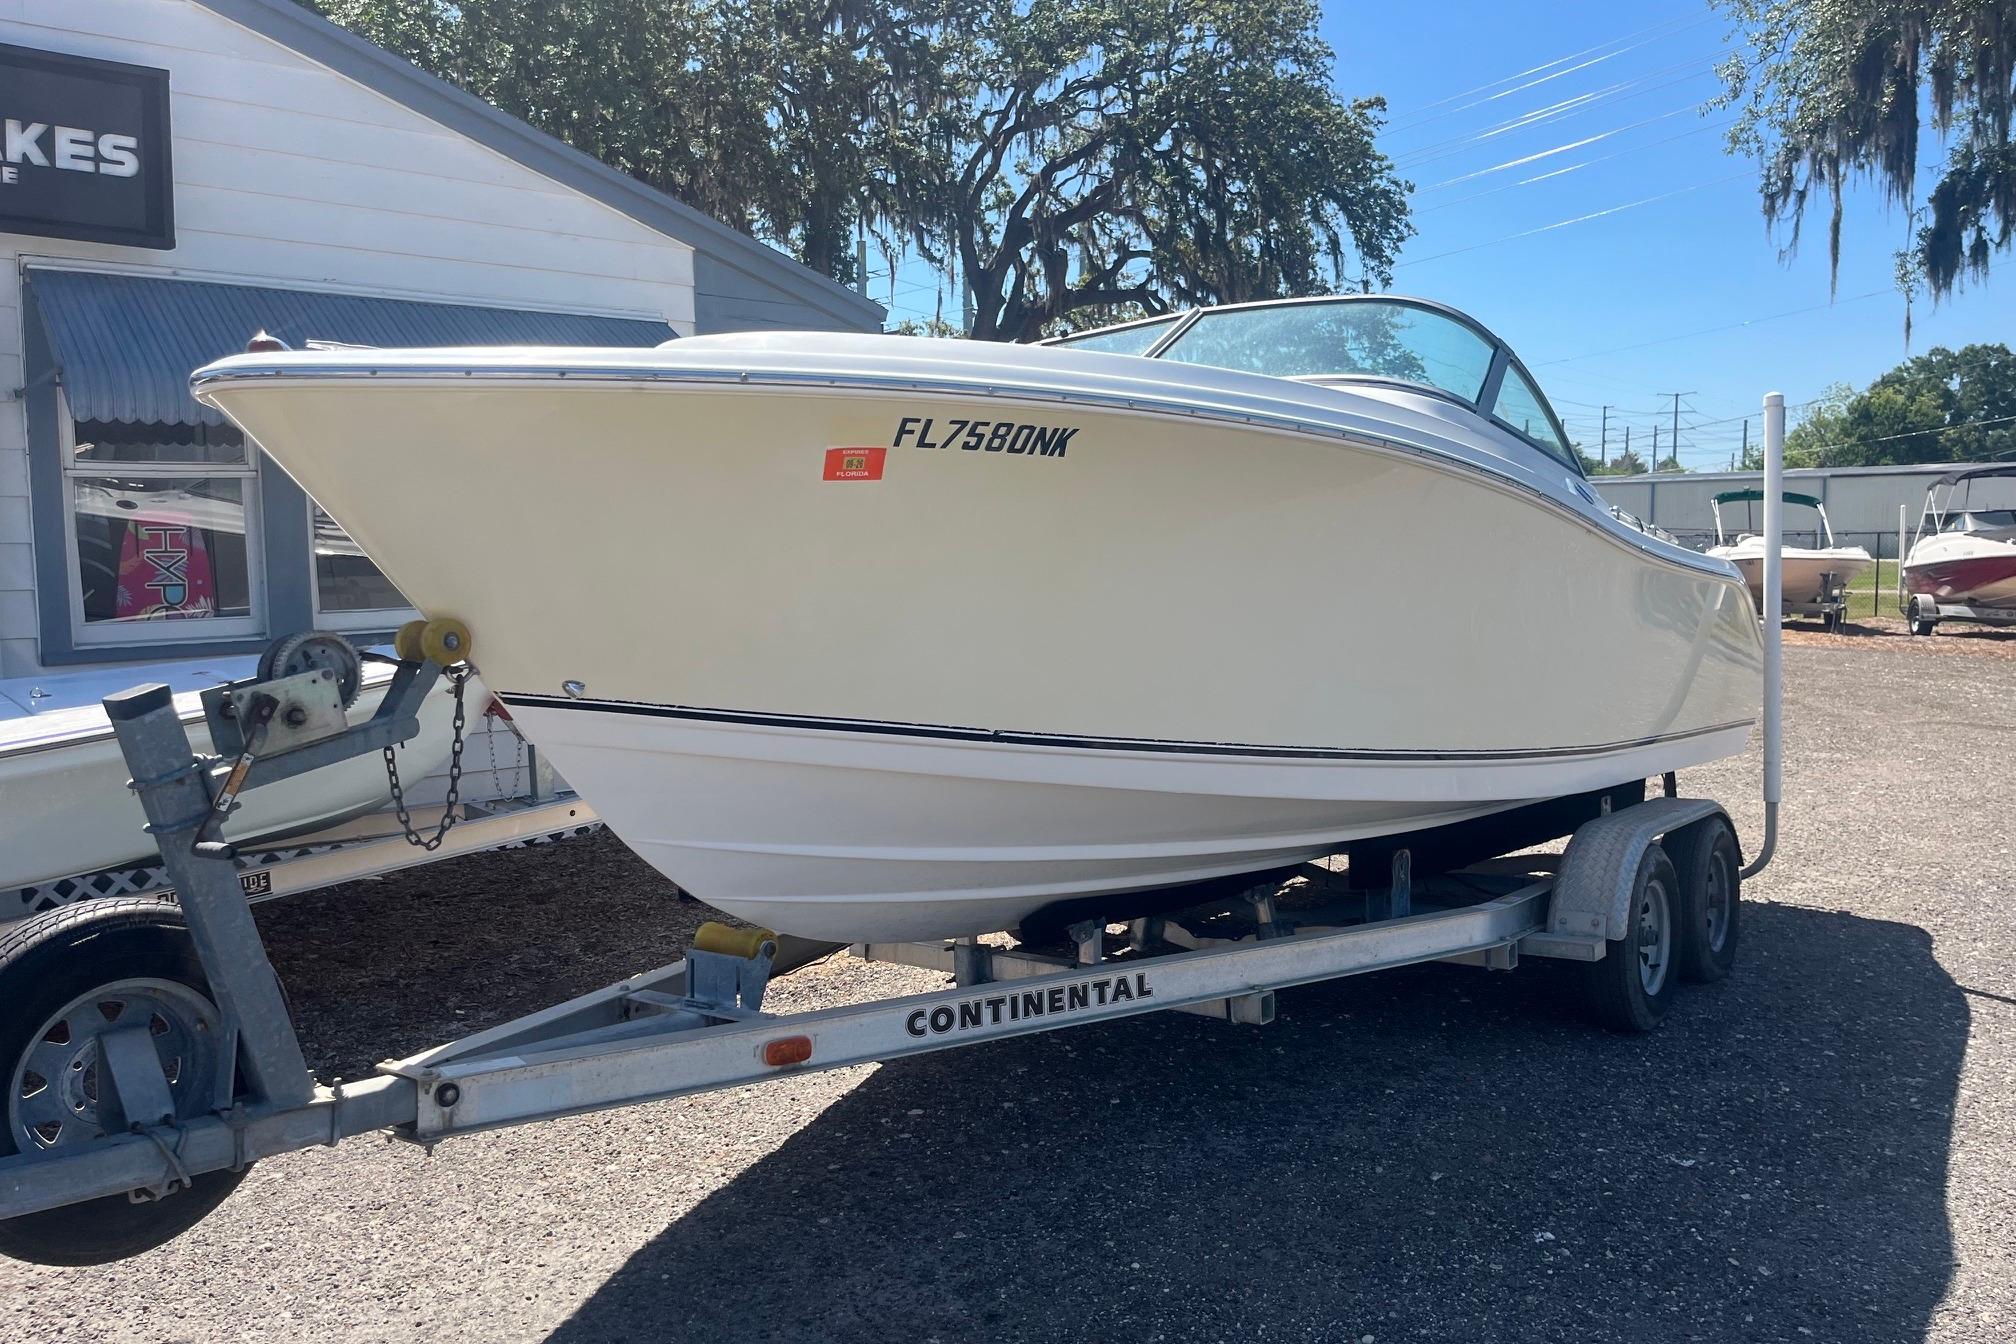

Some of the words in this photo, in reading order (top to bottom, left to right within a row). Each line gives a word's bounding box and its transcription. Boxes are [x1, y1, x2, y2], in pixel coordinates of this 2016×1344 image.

[0, 118, 140, 178] KES
[0, 166, 19, 184] E
[892, 417, 1080, 458] FL7580NK
[904, 972, 1154, 1039] CONTINENTAL
